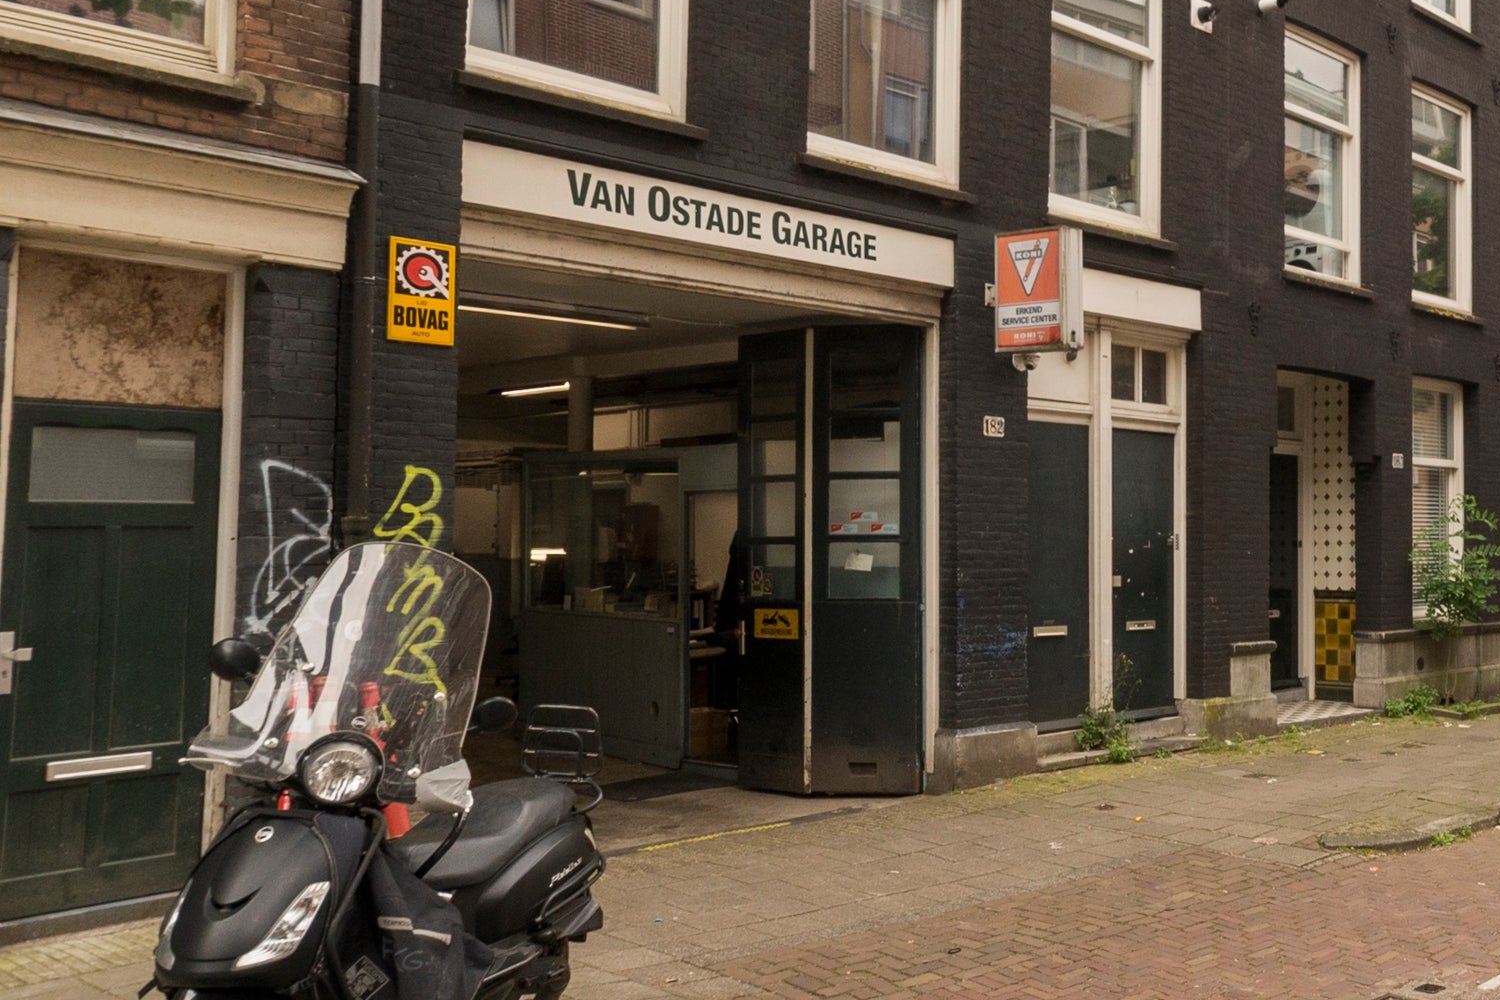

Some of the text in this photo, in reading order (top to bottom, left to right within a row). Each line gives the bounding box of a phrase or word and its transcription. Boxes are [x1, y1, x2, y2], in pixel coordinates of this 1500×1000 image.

[567, 168, 877, 262] VAN OSTADE GARAGE
[1015, 249, 1041, 260] KONI
[1016, 306, 1042, 315] ERKEND
[394, 304, 449, 331] BOVAG
[1002, 314, 1057, 326] SERVICE CENTER
[1014, 332, 1037, 340] KONI
[985, 419, 1003, 435] 182
